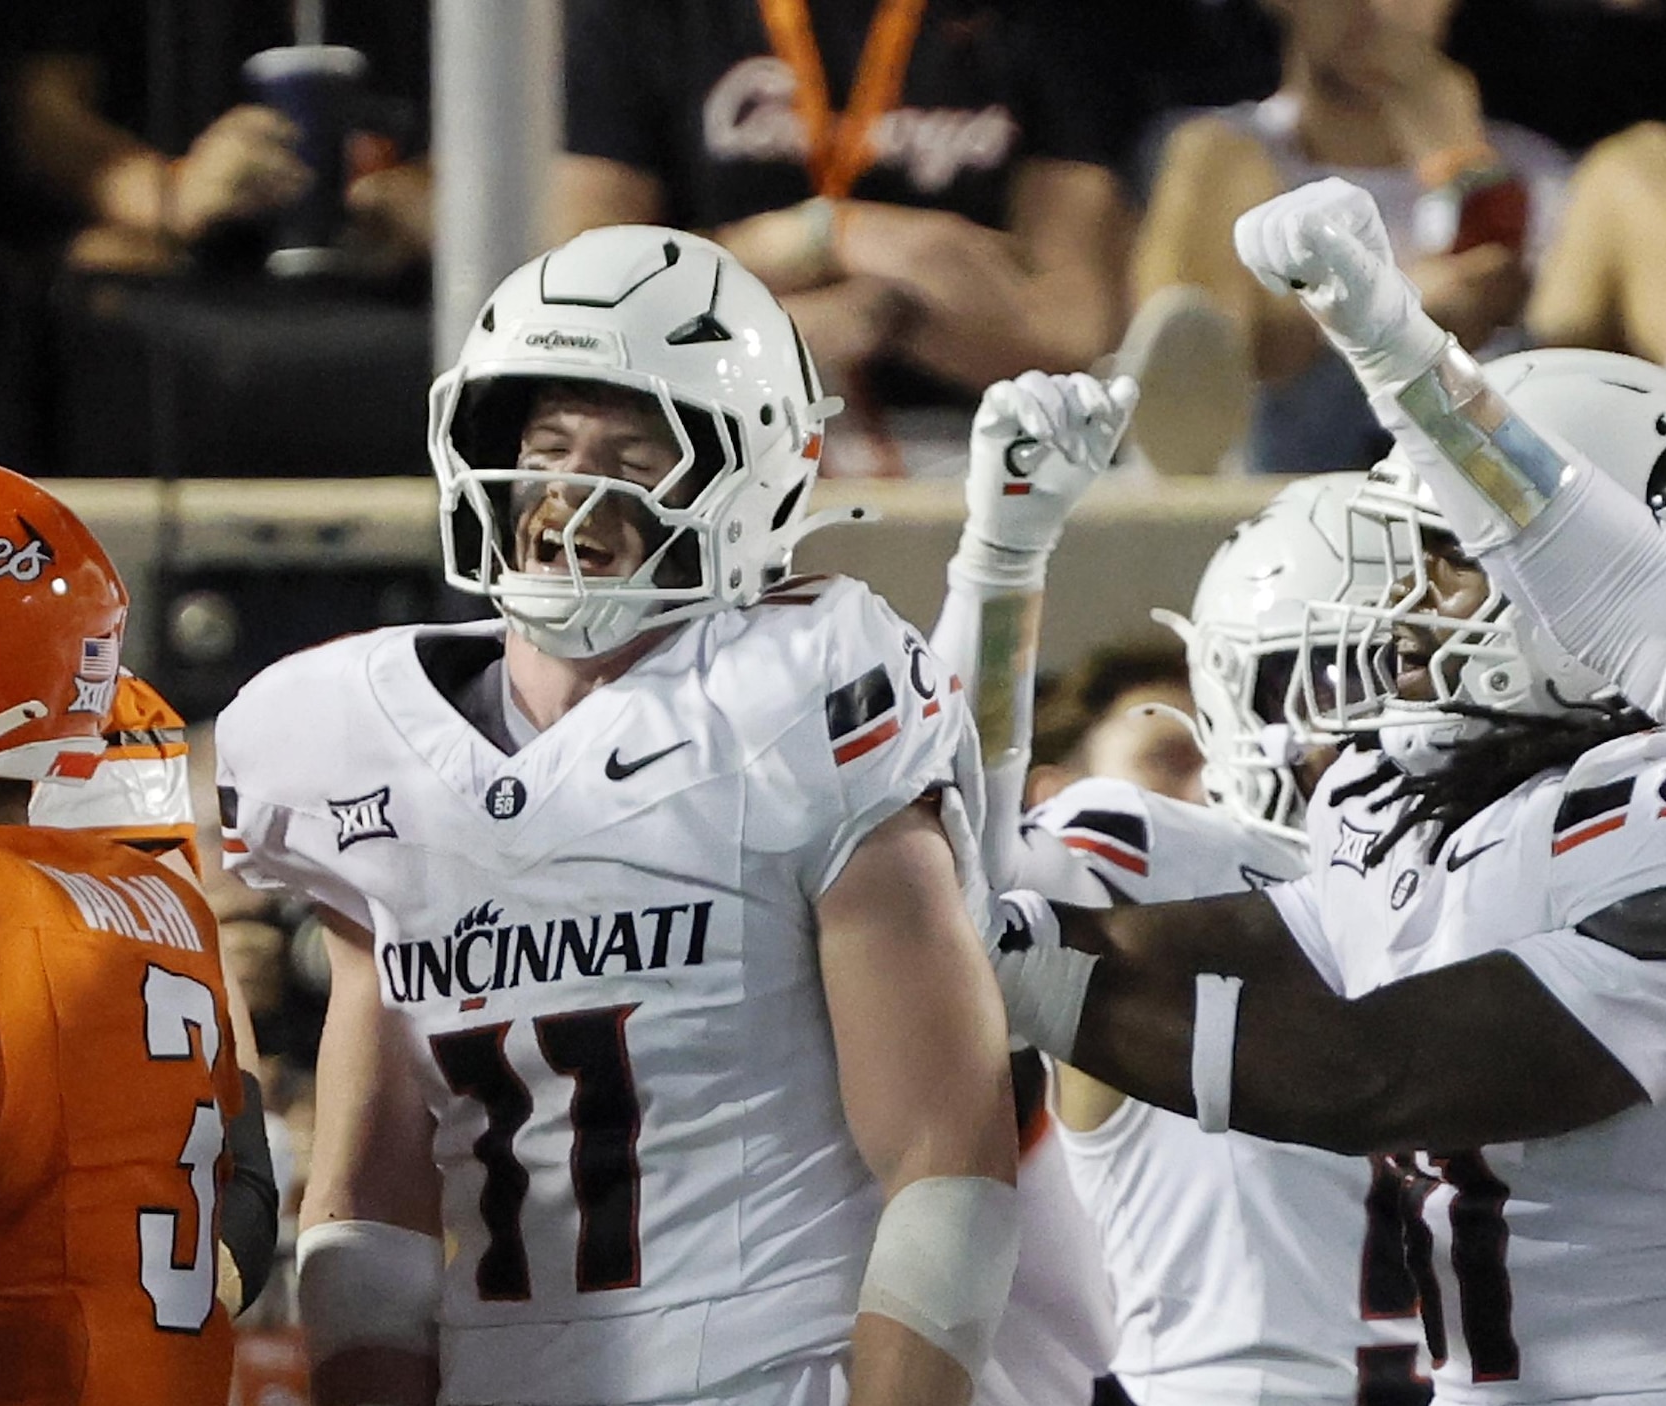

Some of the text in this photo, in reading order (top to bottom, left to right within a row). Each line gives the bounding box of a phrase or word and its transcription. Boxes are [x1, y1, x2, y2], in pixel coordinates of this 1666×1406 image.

[493, 797, 514, 815] 58
[382, 900, 715, 1002] CINCINNATI
[138, 963, 224, 1336] 3
[428, 1001, 644, 1302] 11
